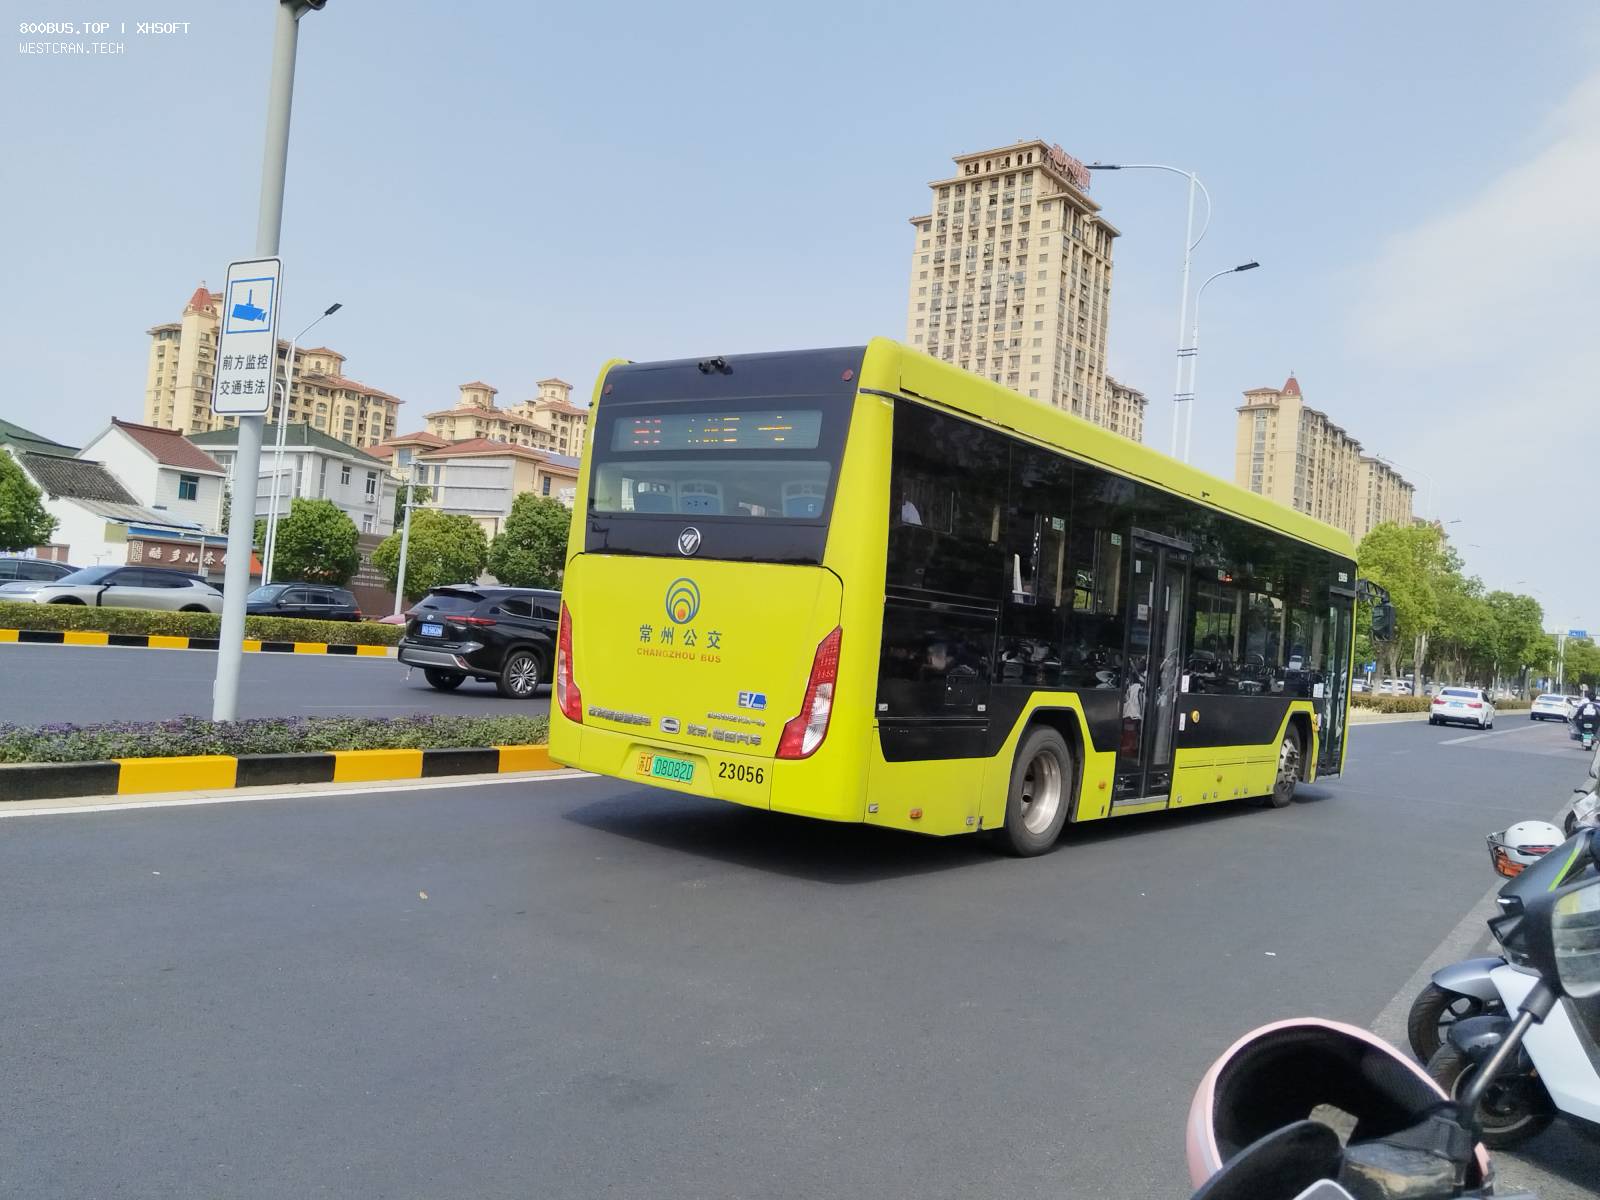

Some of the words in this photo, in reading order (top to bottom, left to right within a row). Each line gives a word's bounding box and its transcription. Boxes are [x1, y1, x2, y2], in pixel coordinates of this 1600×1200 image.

[222, 354, 269, 371] 前方监控
[219, 379, 266, 396] 交通违法
[639, 623, 722, 650] 常州公交
[636, 647, 696, 661] CHANGZHOU
[700, 653, 722, 664] BUS
[718, 761, 765, 785] 23056
